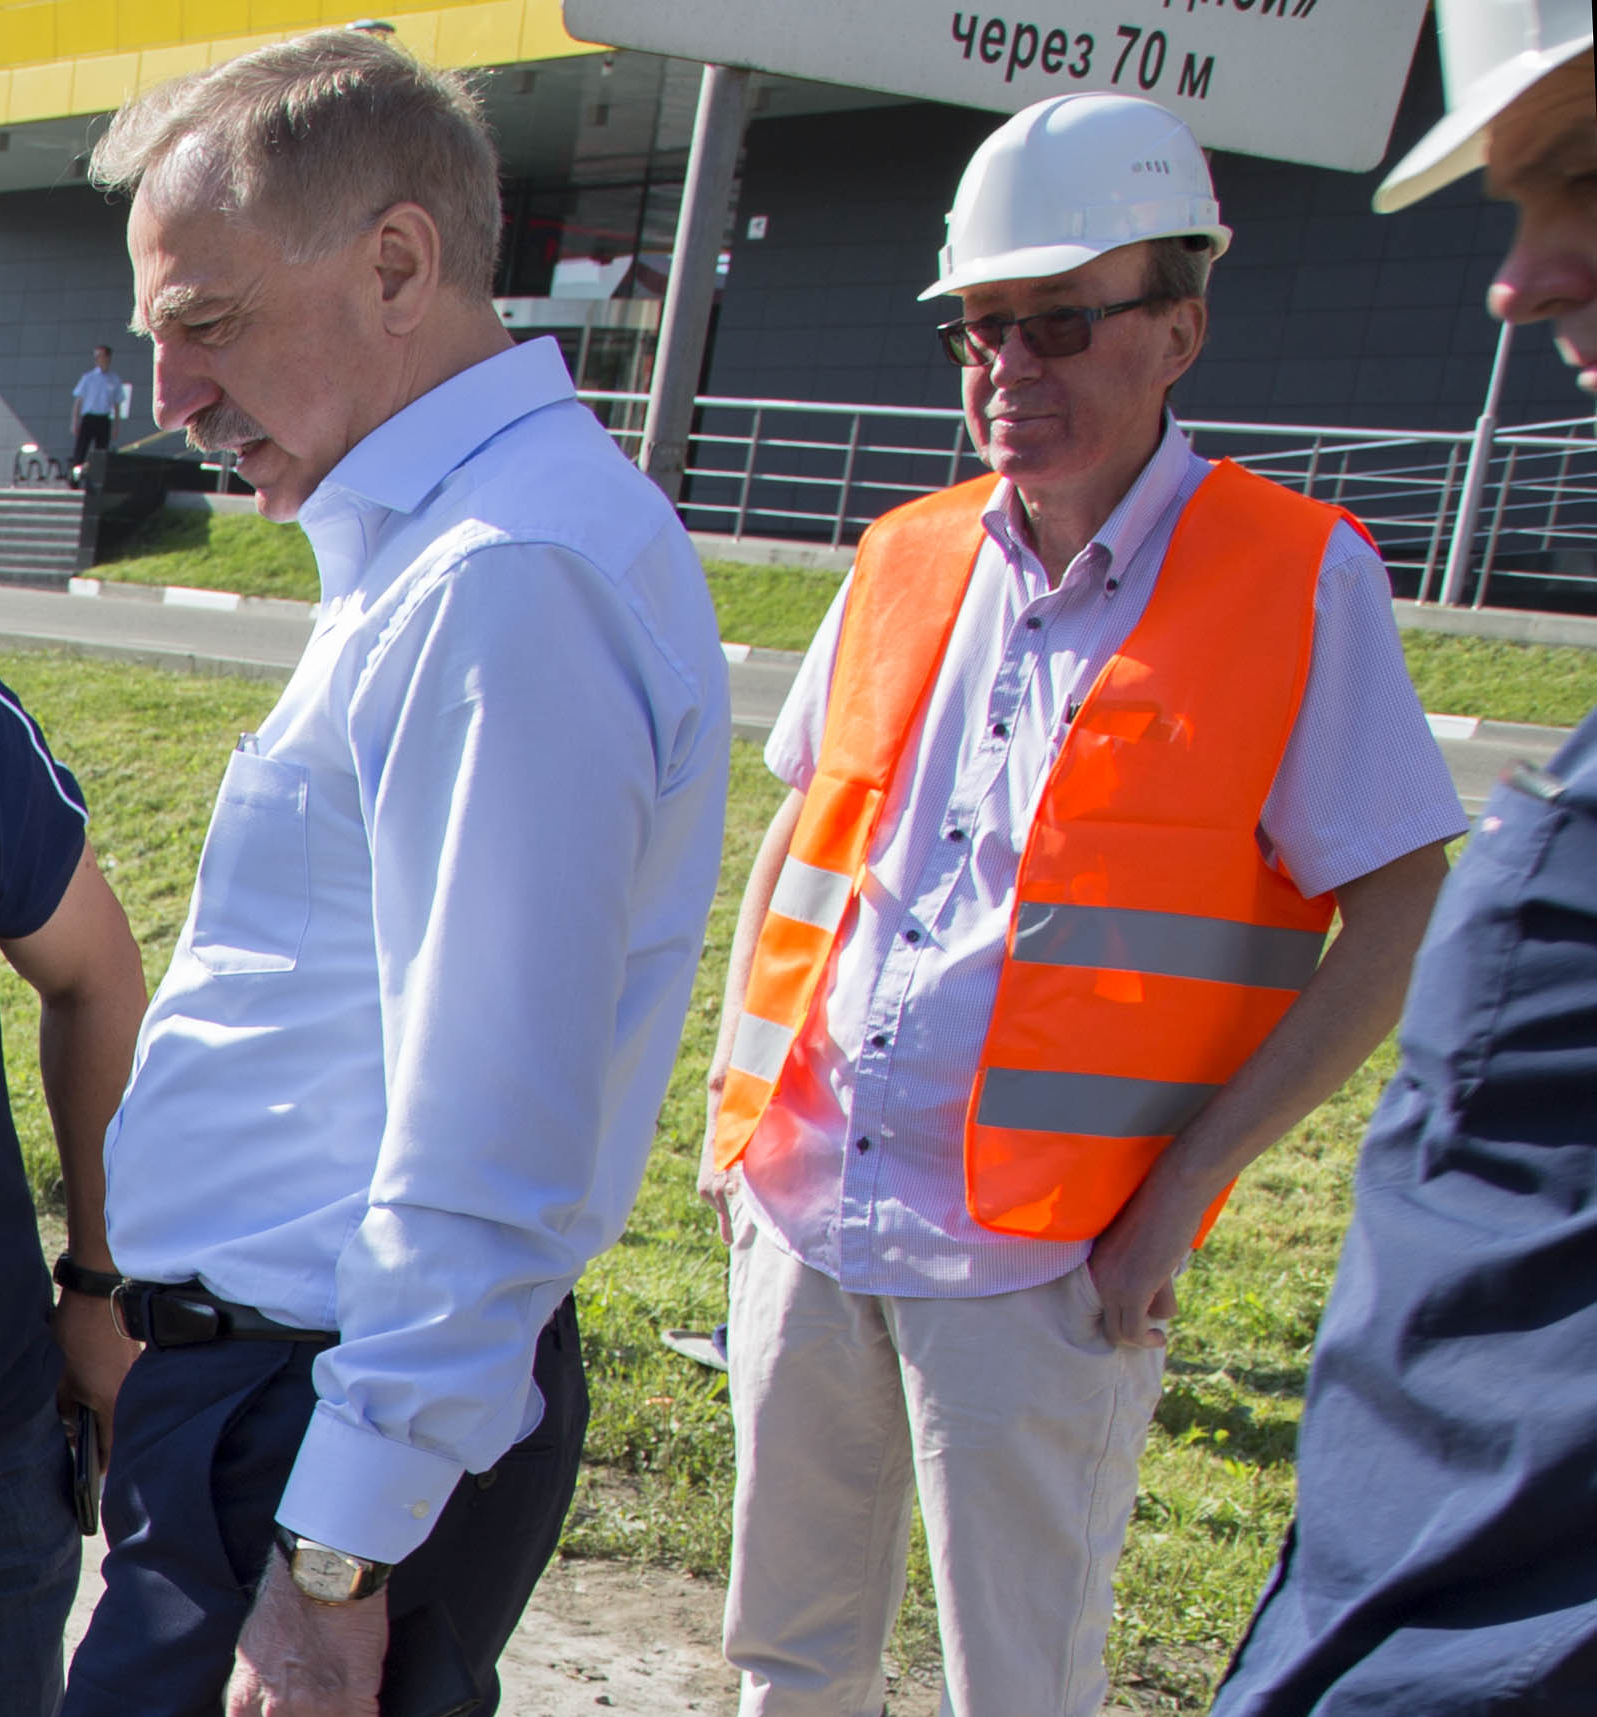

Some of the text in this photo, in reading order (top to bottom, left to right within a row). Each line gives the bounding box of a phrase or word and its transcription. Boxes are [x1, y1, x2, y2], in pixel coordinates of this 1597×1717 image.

[951, 12, 1217, 100] через 70 м
